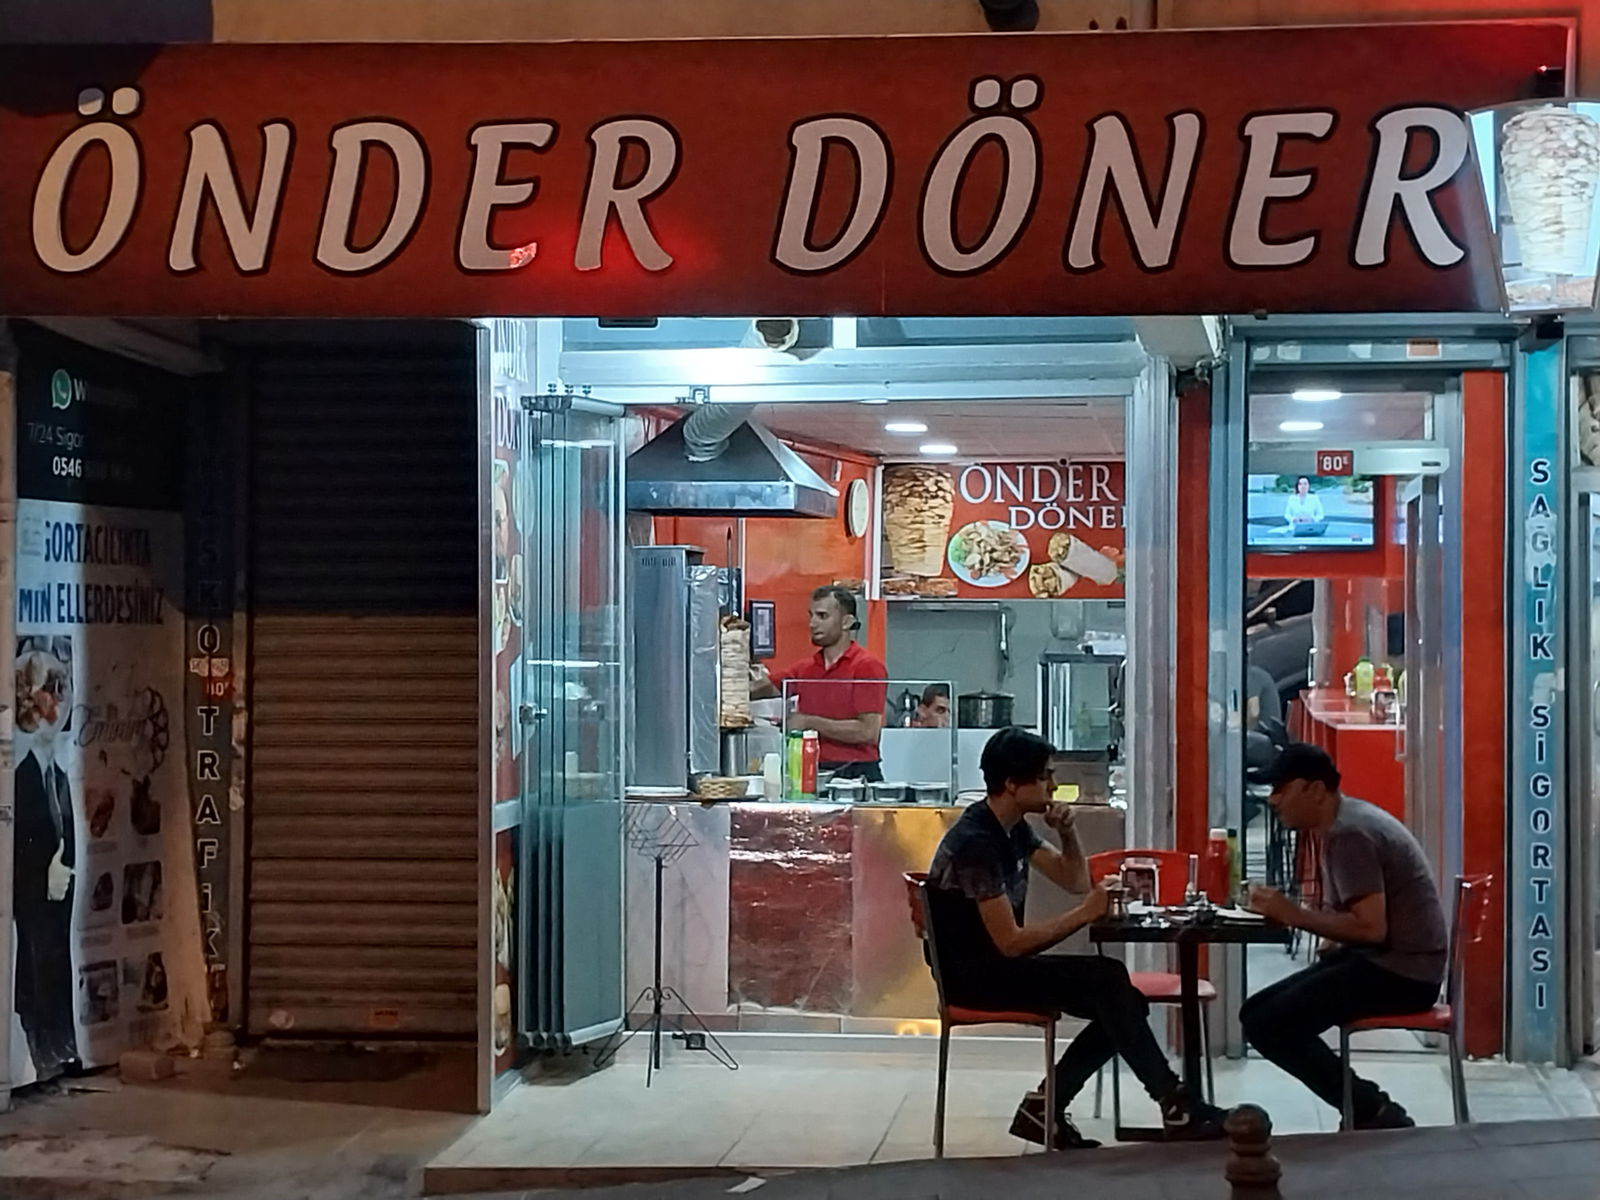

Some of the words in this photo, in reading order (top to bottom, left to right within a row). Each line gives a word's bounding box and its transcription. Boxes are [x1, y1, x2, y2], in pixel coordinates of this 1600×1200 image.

[31, 86, 676, 273] ÖNDER
[775, 77, 1468, 273] DÖNER
[52, 455, 83, 479] 0546
[1529, 704, 1555, 1010] SİGORTASI
